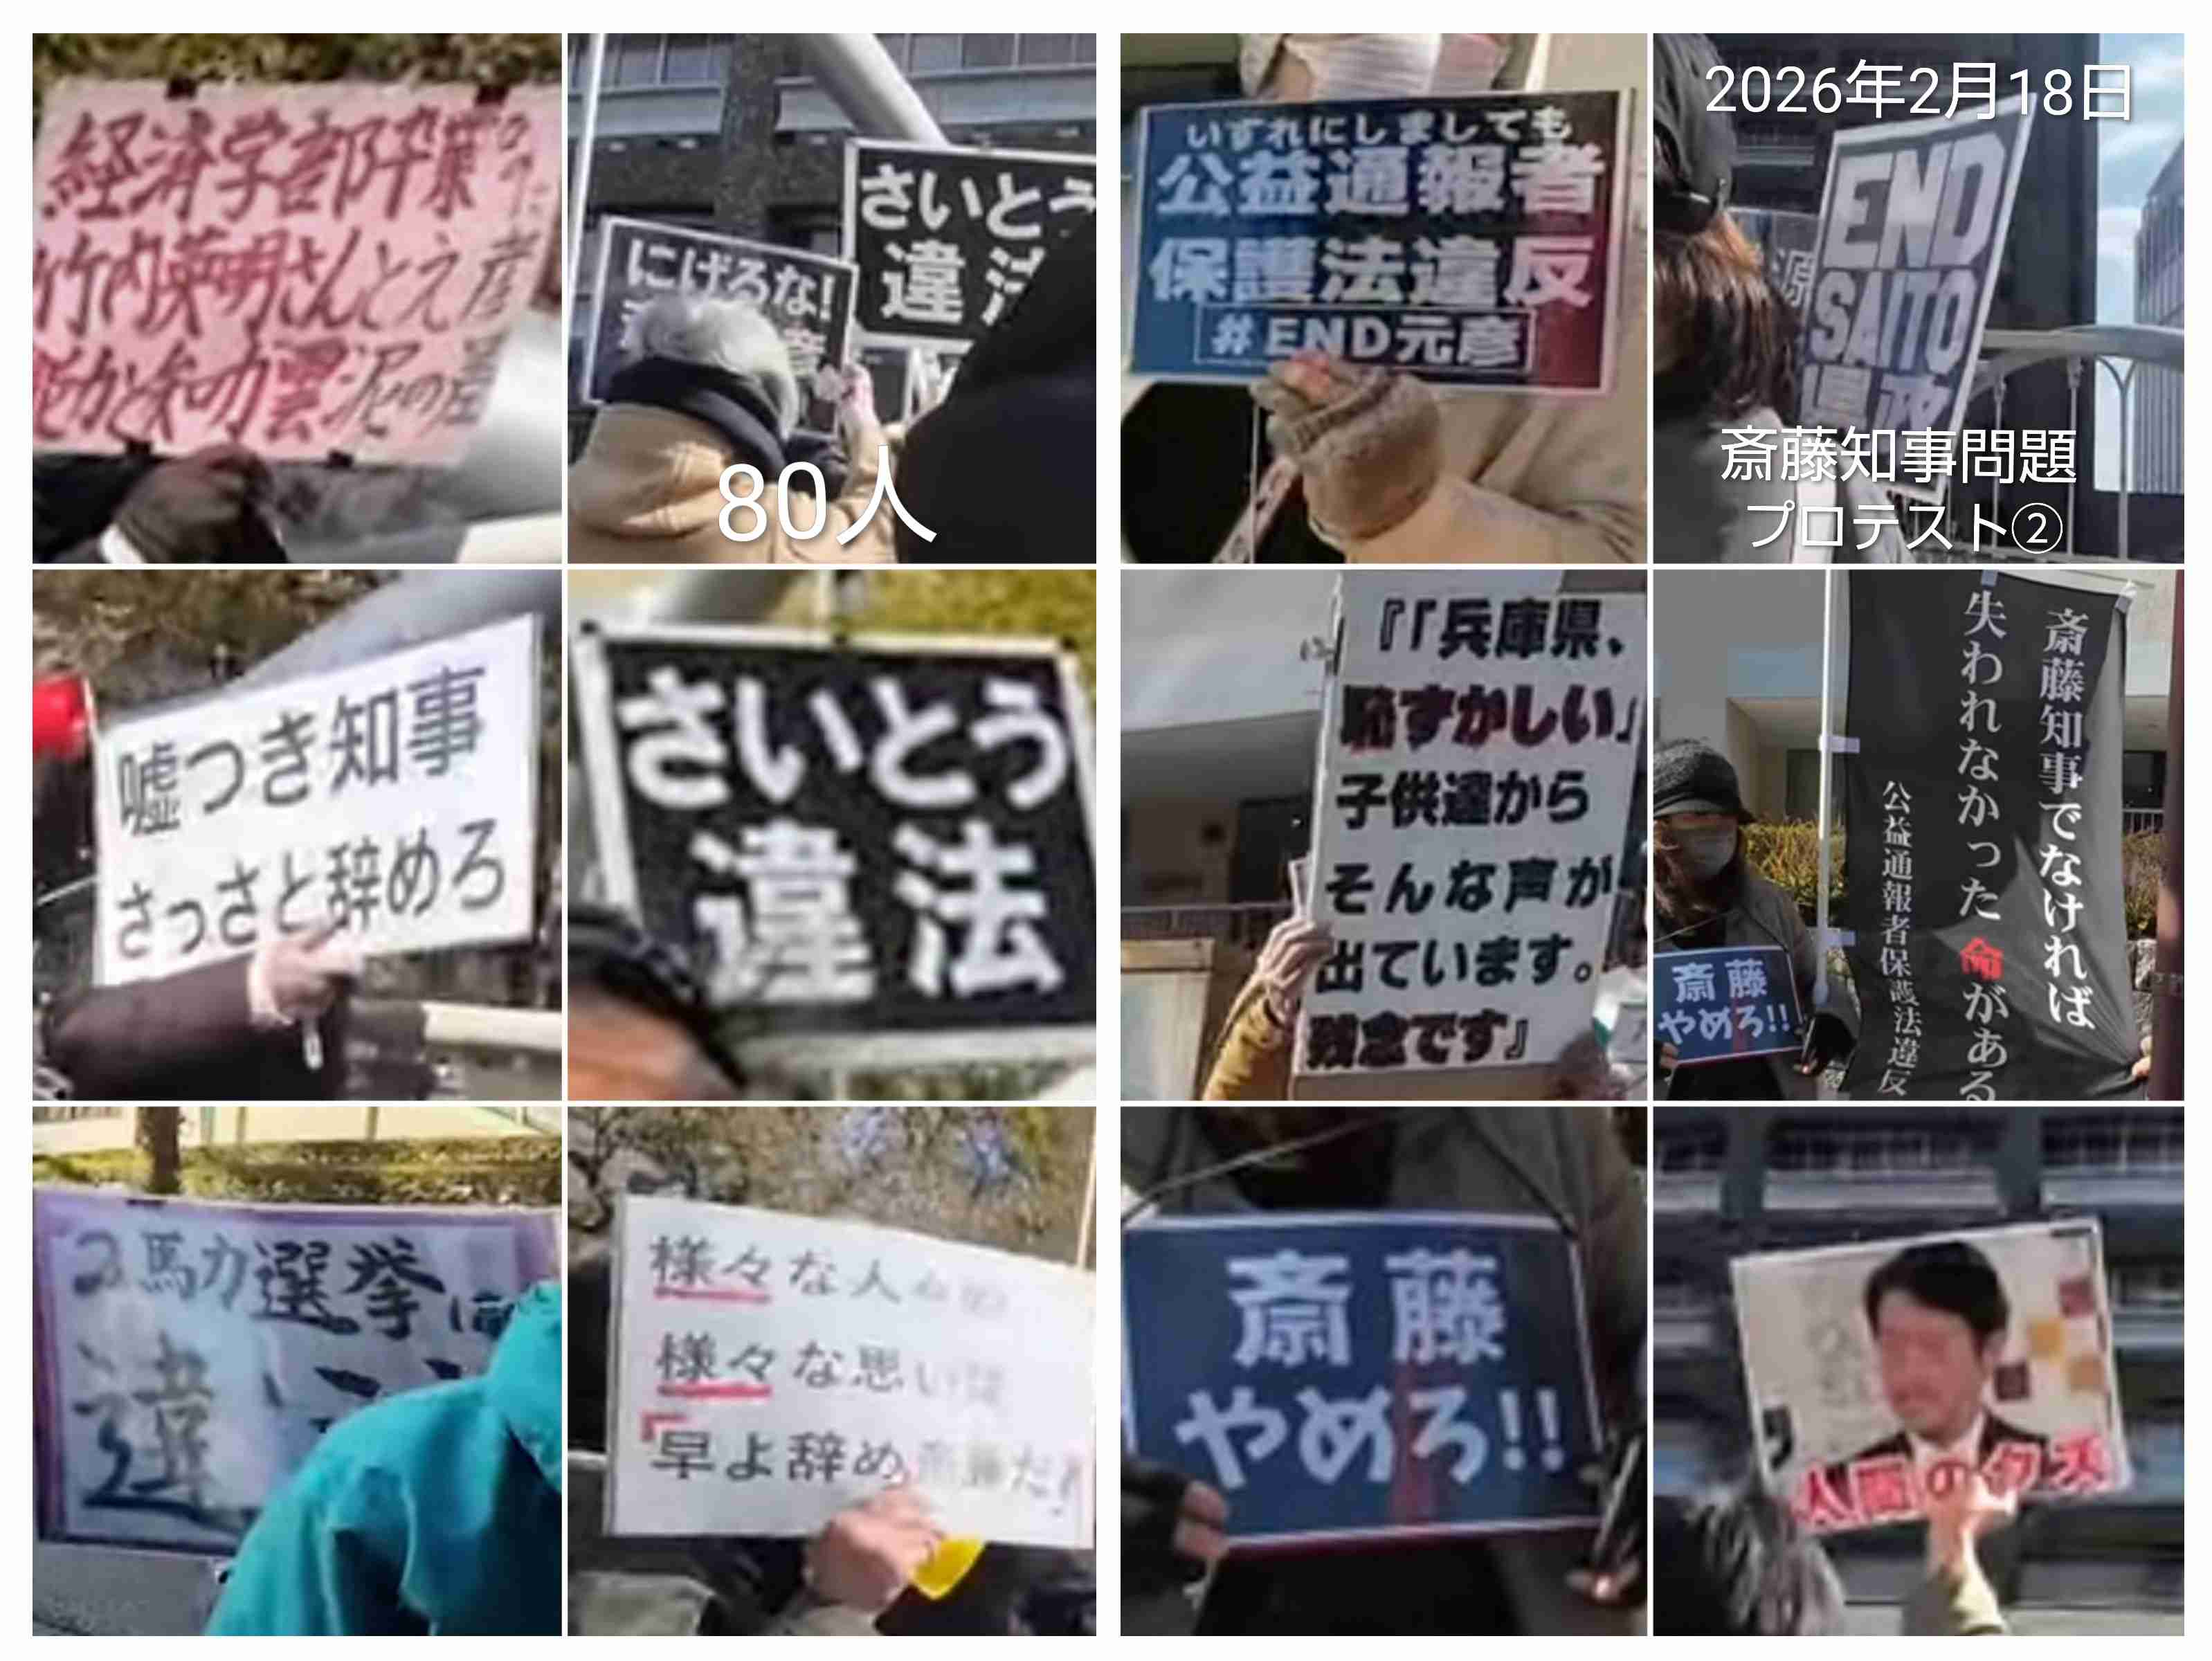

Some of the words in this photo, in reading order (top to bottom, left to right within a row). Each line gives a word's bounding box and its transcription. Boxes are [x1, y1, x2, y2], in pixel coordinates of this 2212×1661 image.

[1157, 141, 1607, 217] 公益通報者
[1186, 105, 1572, 149] いずれにしましても
[1820, 130, 2007, 271] END
[1146, 234, 1593, 310] 保護法違反
[1808, 269, 1978, 377] SAITO
[116, 664, 487, 837] 嘘つき知事
[616, 664, 1069, 810] さいとう
[1336, 770, 1590, 831] 子供達から
[2036, 607, 2096, 1031] 斎藤知事でなければ
[116, 817, 507, 962] さっさと辞めろ
[689, 817, 1066, 1006] 違法
[1324, 853, 1615, 916] そんな声が
[1877, 779, 1923, 1097] 公益通報者保護法違反
[1315, 933, 1594, 995] 出ています。
[1671, 957, 1769, 1004] 斎藤
[1657, 1002, 1792, 1046] やめろ!!
[1226, 1247, 1510, 1368] 斎藤
[1175, 1386, 1567, 1492] やめろ!!
